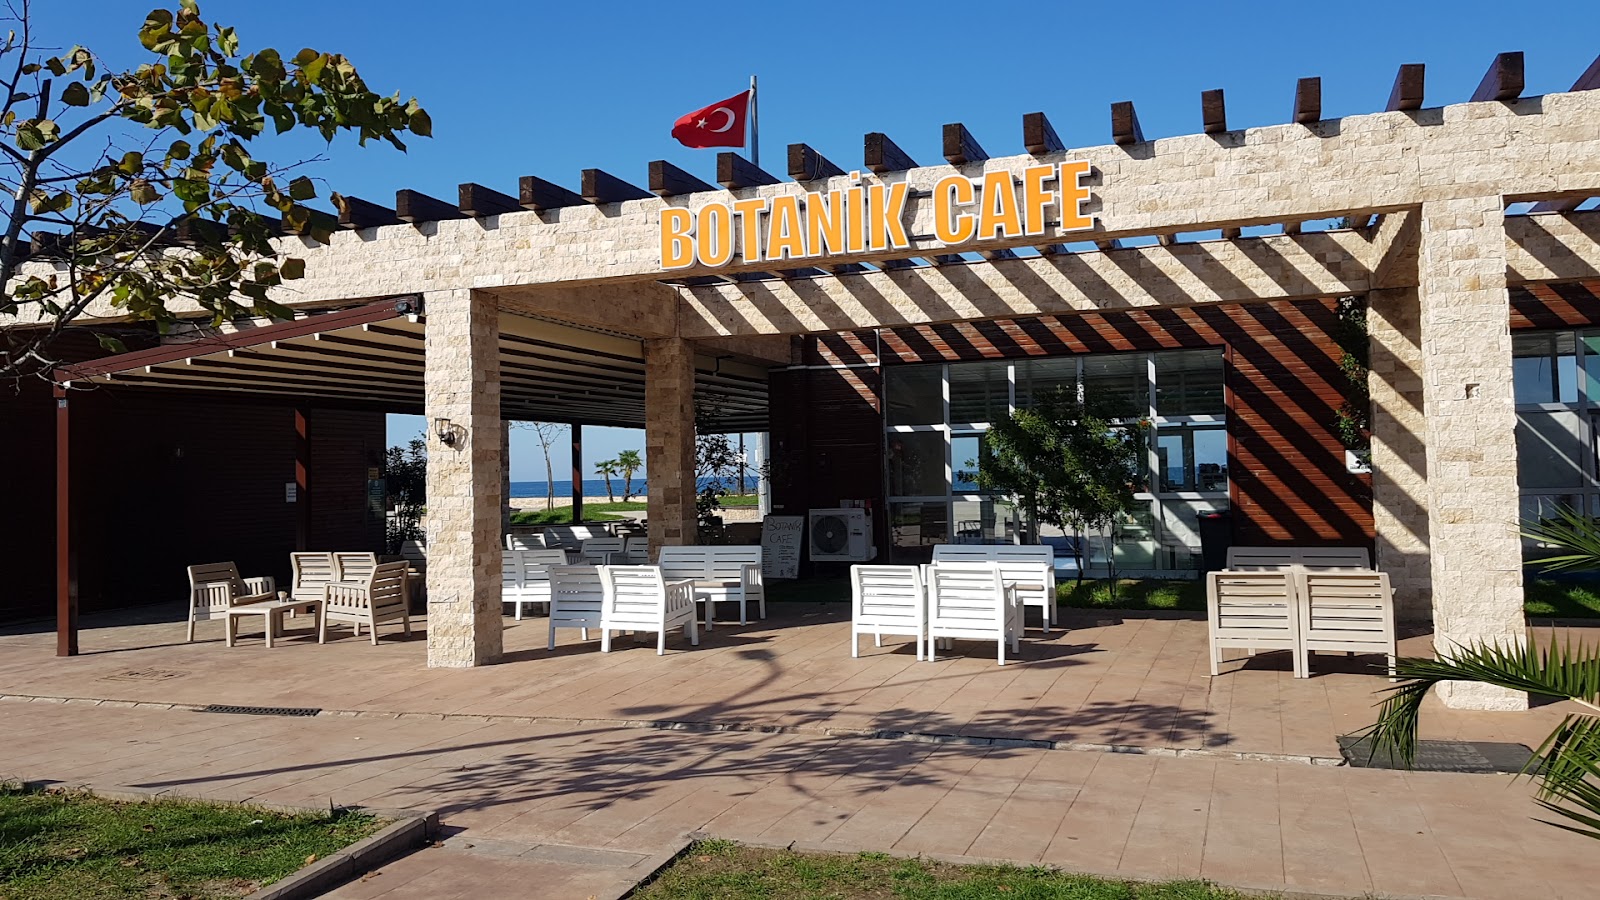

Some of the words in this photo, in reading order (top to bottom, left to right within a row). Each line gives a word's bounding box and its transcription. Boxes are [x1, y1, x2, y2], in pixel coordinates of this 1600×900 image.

[659, 170, 910, 271] BOTANİK
[933, 159, 1095, 245] CAFE
[770, 533, 793, 543] CAFE
